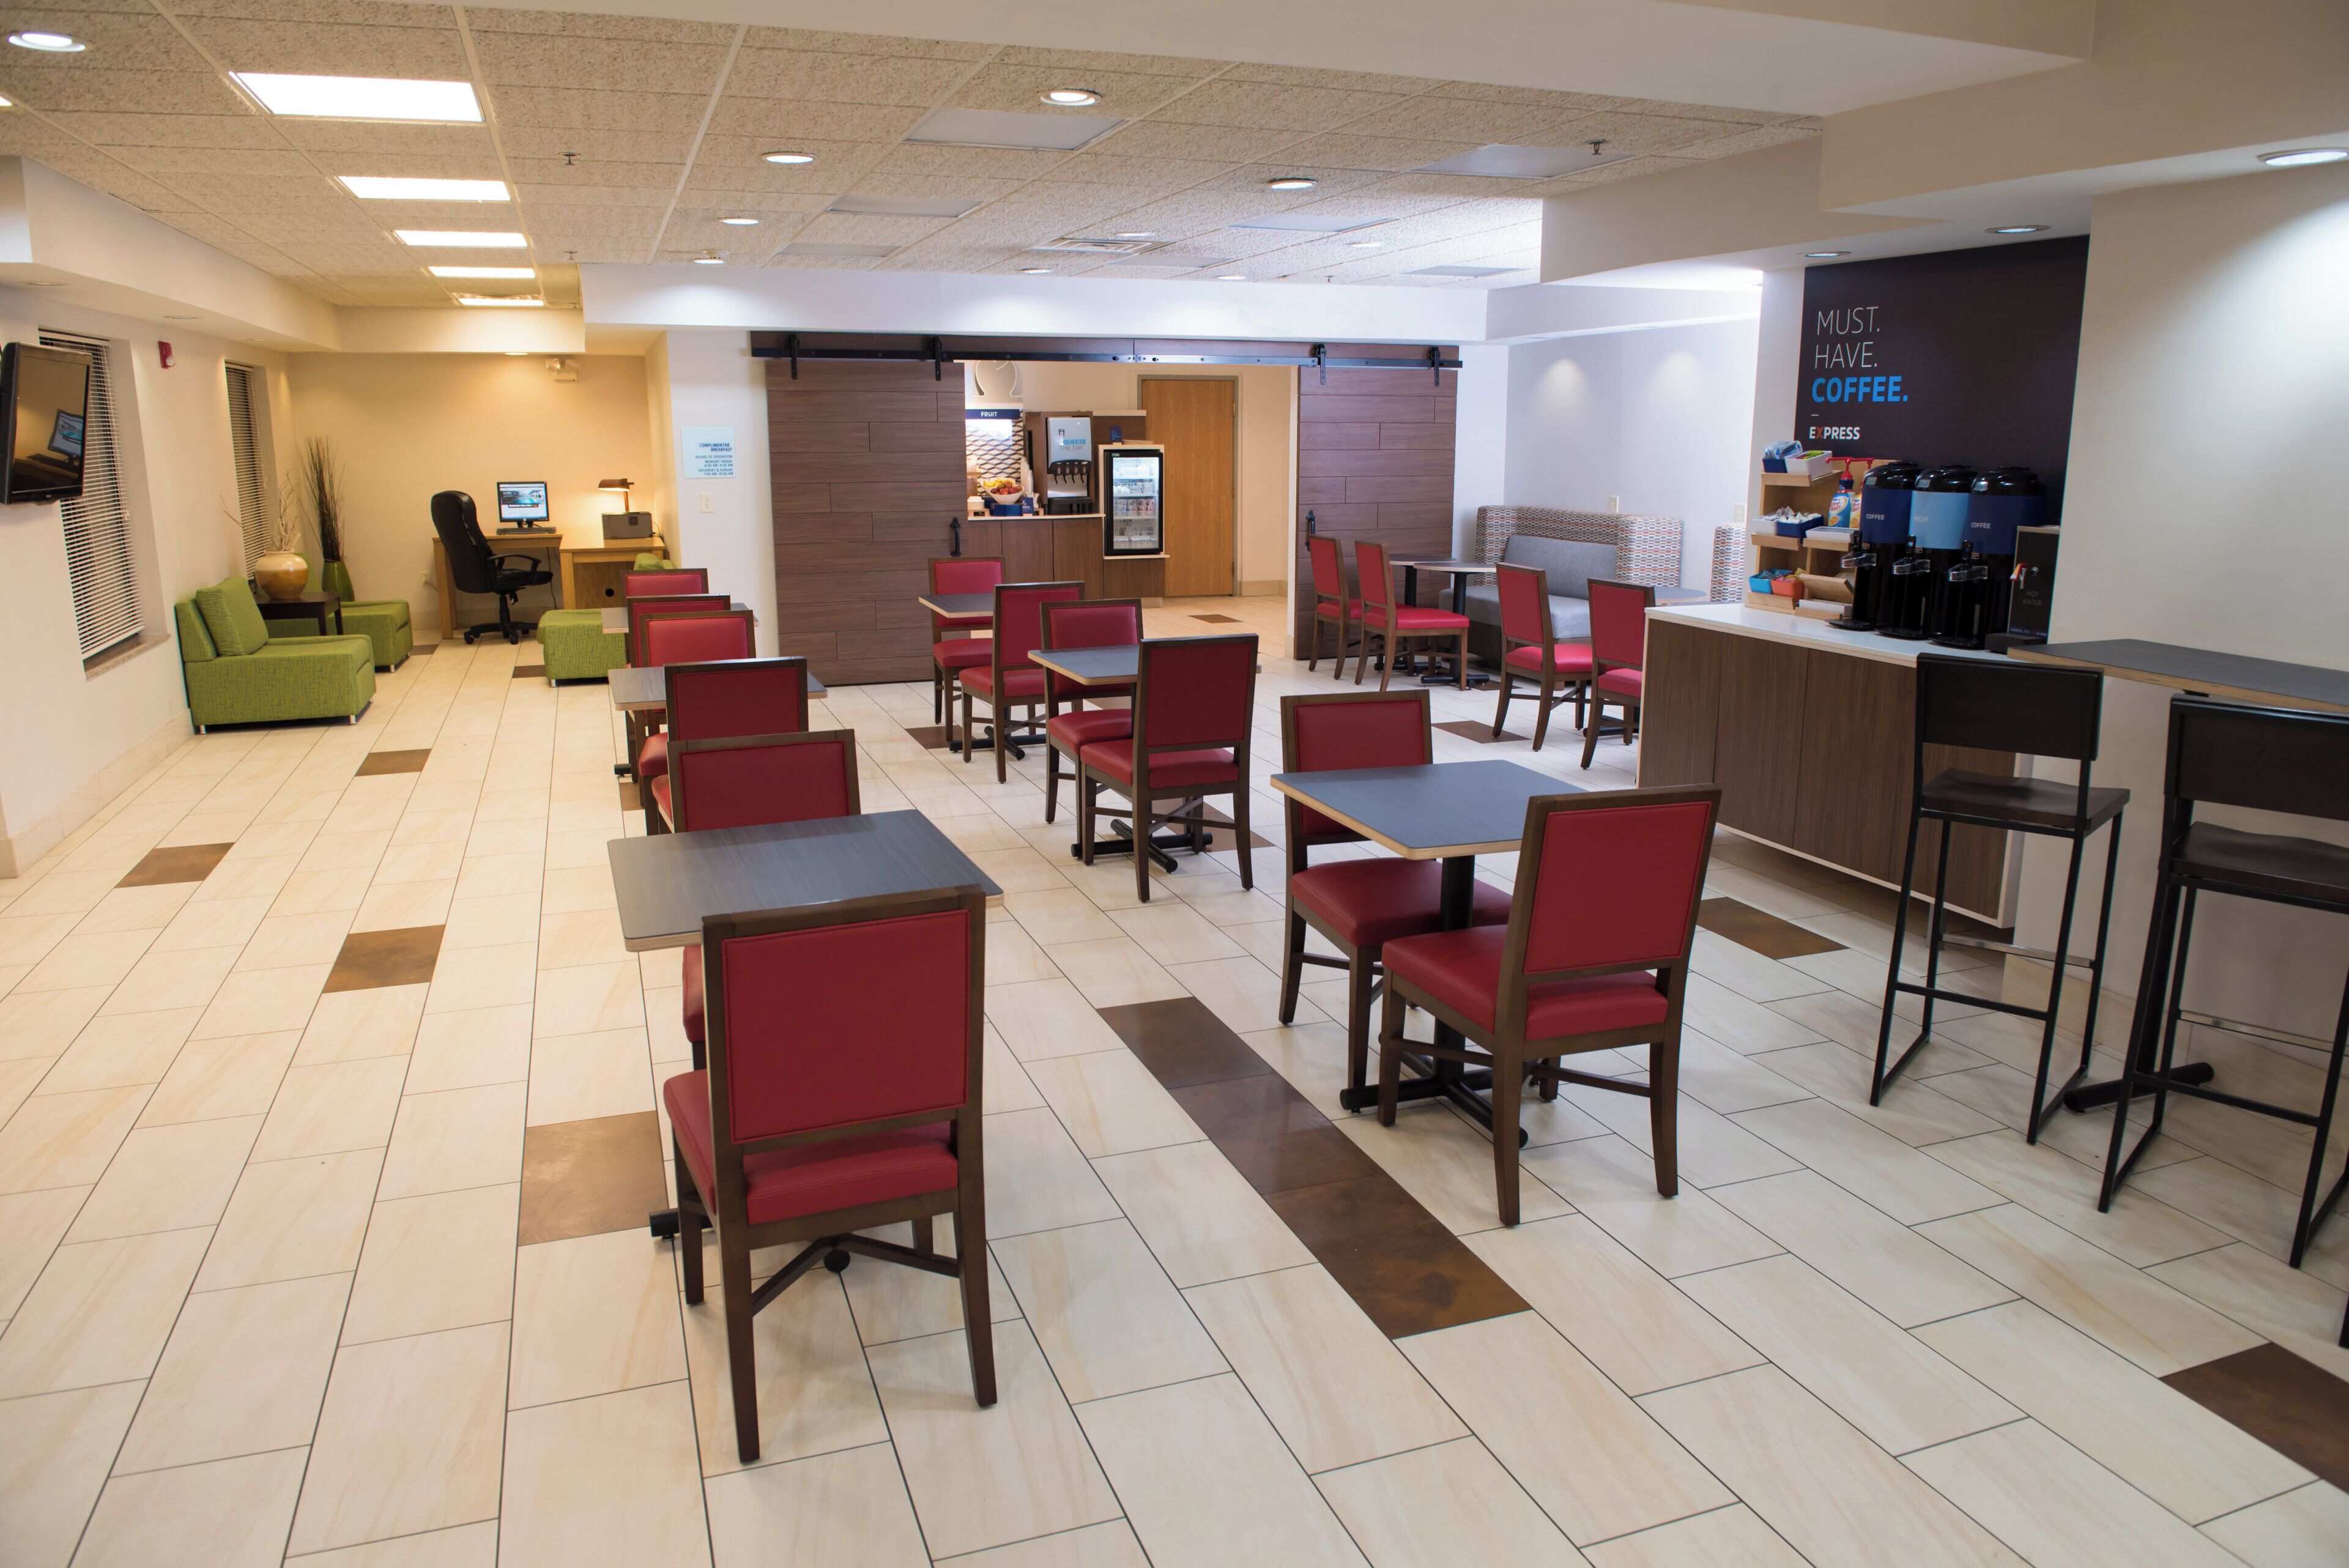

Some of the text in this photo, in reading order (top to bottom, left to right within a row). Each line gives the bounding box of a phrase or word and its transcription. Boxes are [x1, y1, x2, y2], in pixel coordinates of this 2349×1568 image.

[1817, 306, 1880, 335] MUST.
[1814, 341, 1877, 369] HAVE.
[1811, 375, 1909, 403] COFFEE.
[1809, 426, 1860, 439] EXPRESS
